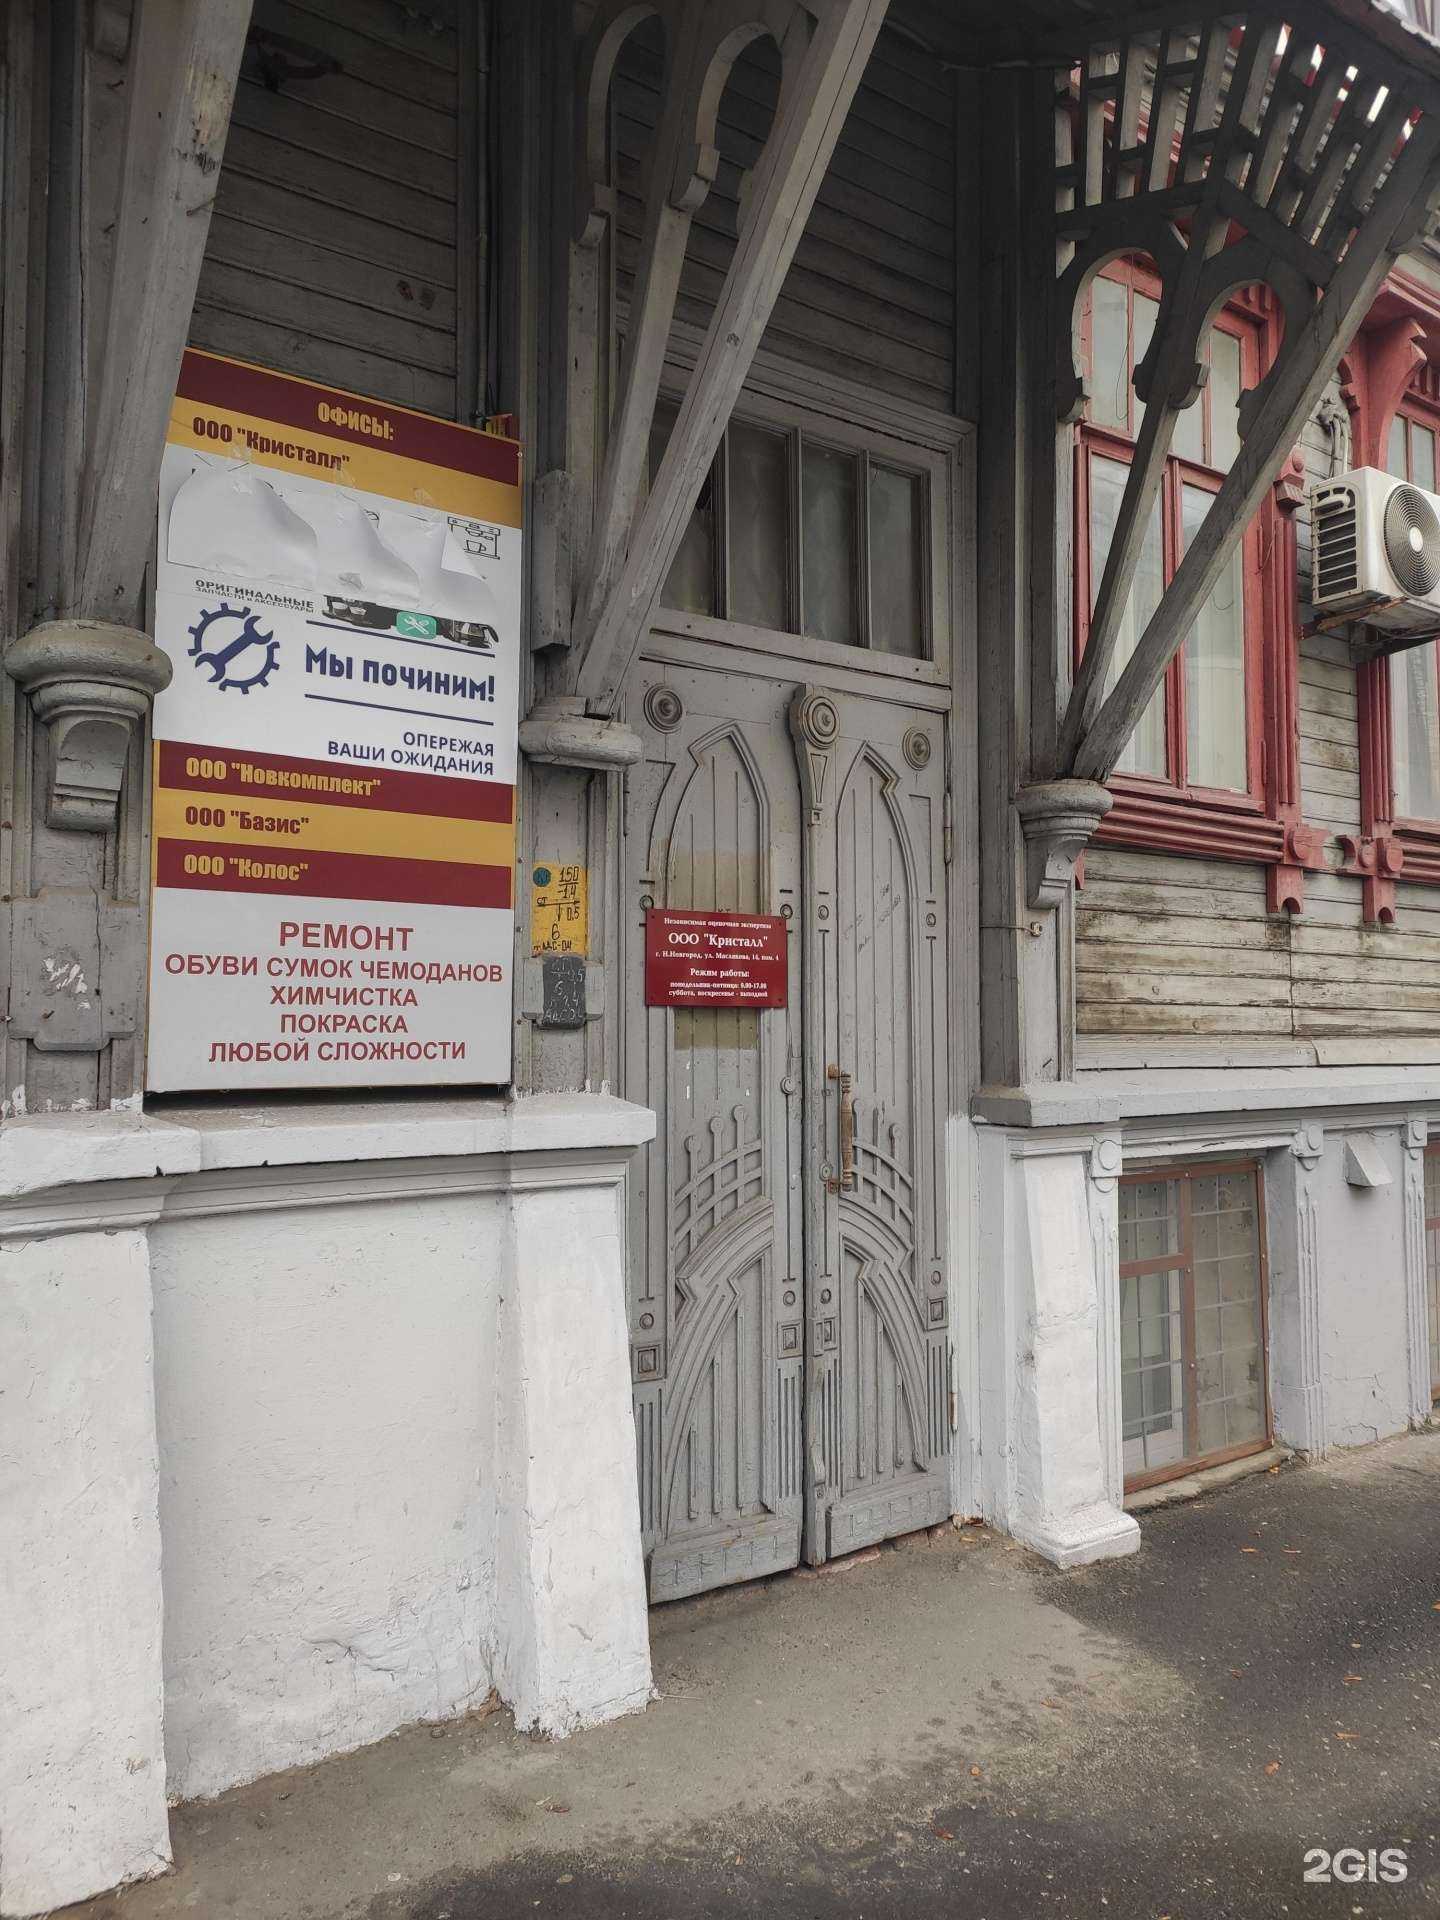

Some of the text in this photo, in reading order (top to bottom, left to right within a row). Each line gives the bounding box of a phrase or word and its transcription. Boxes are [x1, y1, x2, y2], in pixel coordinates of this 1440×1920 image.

[317, 402, 394, 441] Офисы:
[192, 417, 350, 471] ООО "Кристалл"
[195, 579, 314, 609] ОРИГИНАЛЬНЫЕ
[305, 644, 496, 703] Мы починим!
[402, 731, 495, 757] ОПЕРЕЖАЯ
[185, 757, 227, 780] ООО
[327, 741, 494, 776] ВАШИ ОЖИДАНИЯ
[185, 806, 310, 835] ООО "Базис"
[183, 854, 309, 882] ООО "Колос"
[279, 921, 415, 952] РЕМОНТ
[551, 923, 561, 941] 6
[668, 932, 768, 949] ООО "Кристалл"
[164, 953, 503, 984] ОБУВИ СУМОК ЧЕМОДАНОВ
[690, 968, 750, 979] Режим работы:
[269, 985, 419, 1007] ХИМЧИСТКА
[280, 1013, 409, 1034] ПОКРАСКА
[208, 1037, 467, 1063] ЛЮБОЙ СЛОЖНОСТИ
